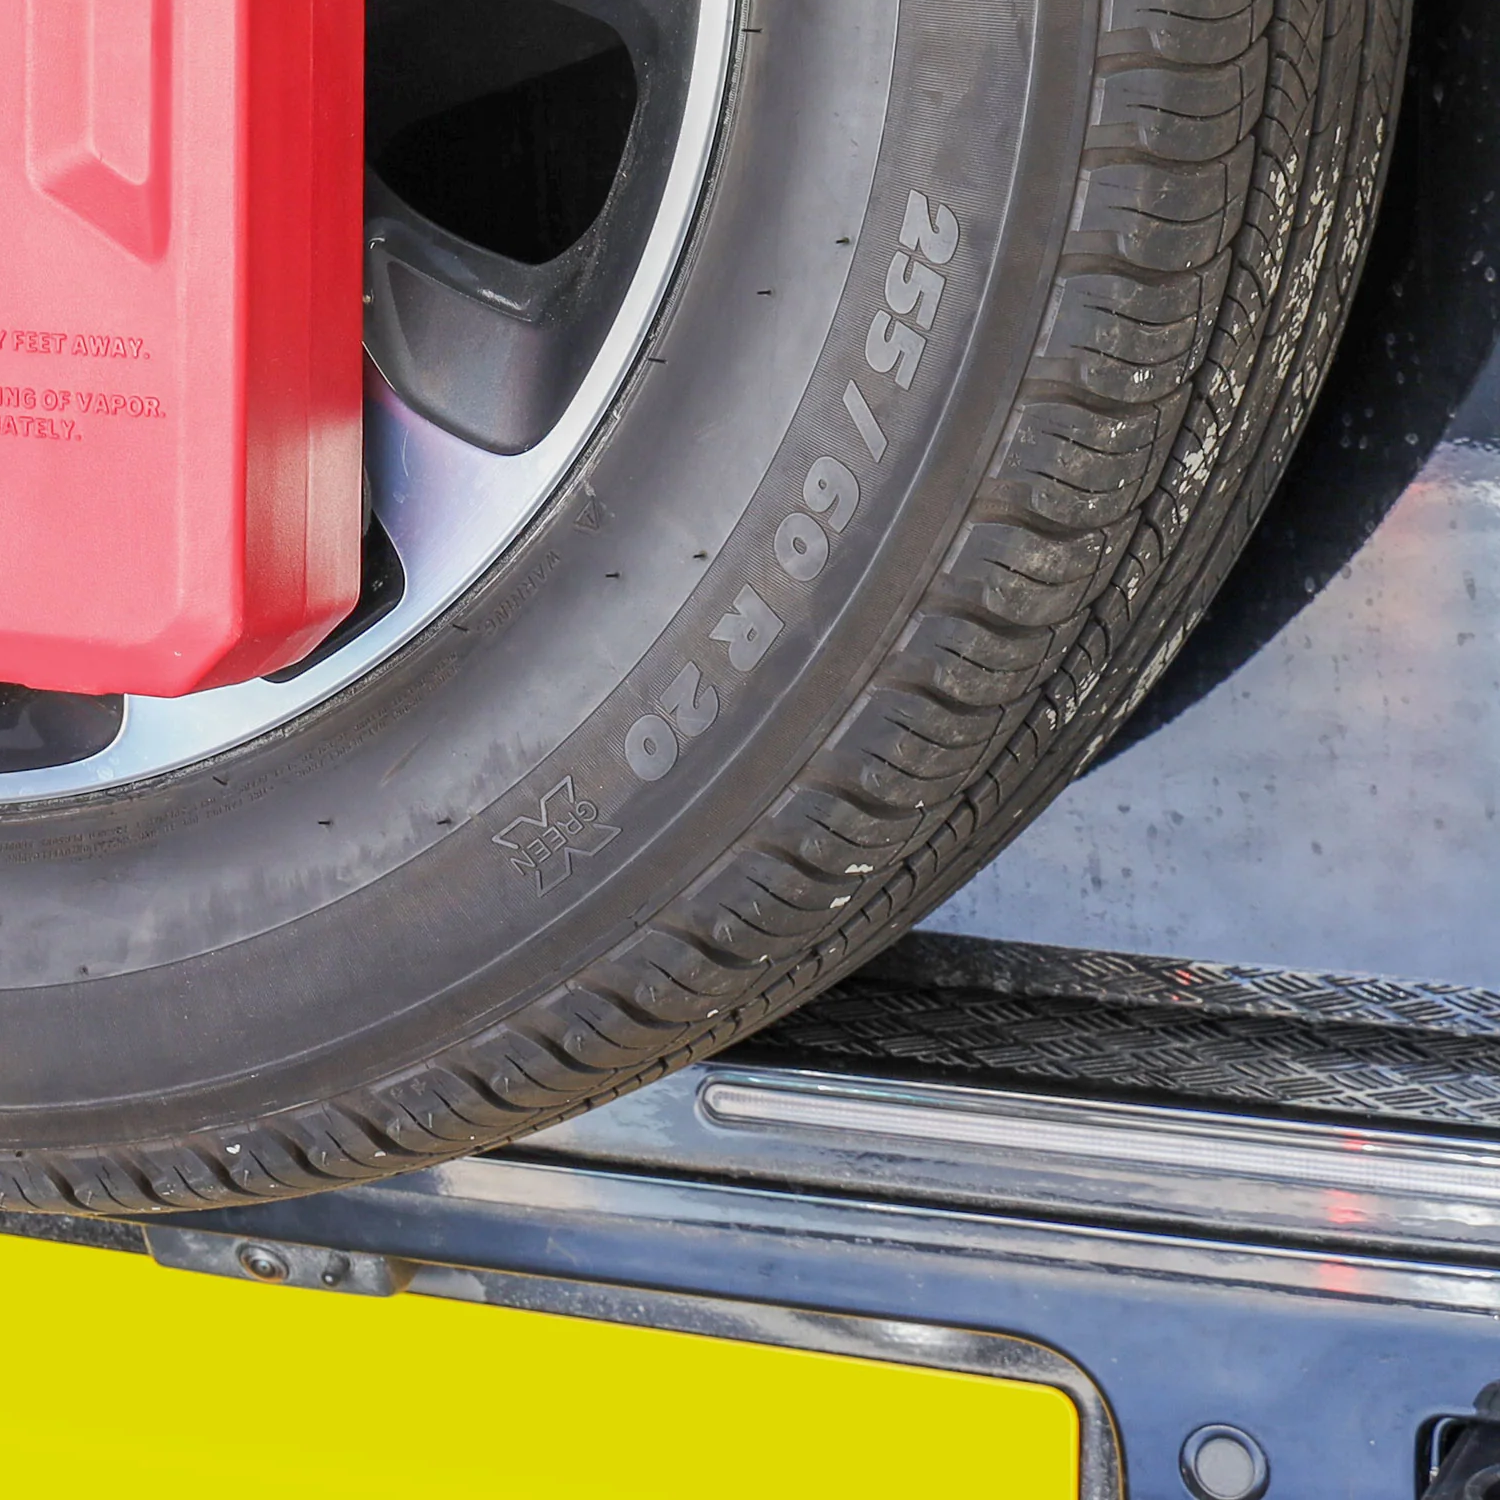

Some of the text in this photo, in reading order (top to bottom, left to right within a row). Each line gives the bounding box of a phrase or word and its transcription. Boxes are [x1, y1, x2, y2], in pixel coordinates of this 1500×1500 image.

[12, 331, 67, 354] FEET
[72, 335, 151, 359] AWAY.
[43, 389, 71, 411] OF
[76, 393, 167, 418] VAPOR.
[510, 799, 600, 878] GREEN
